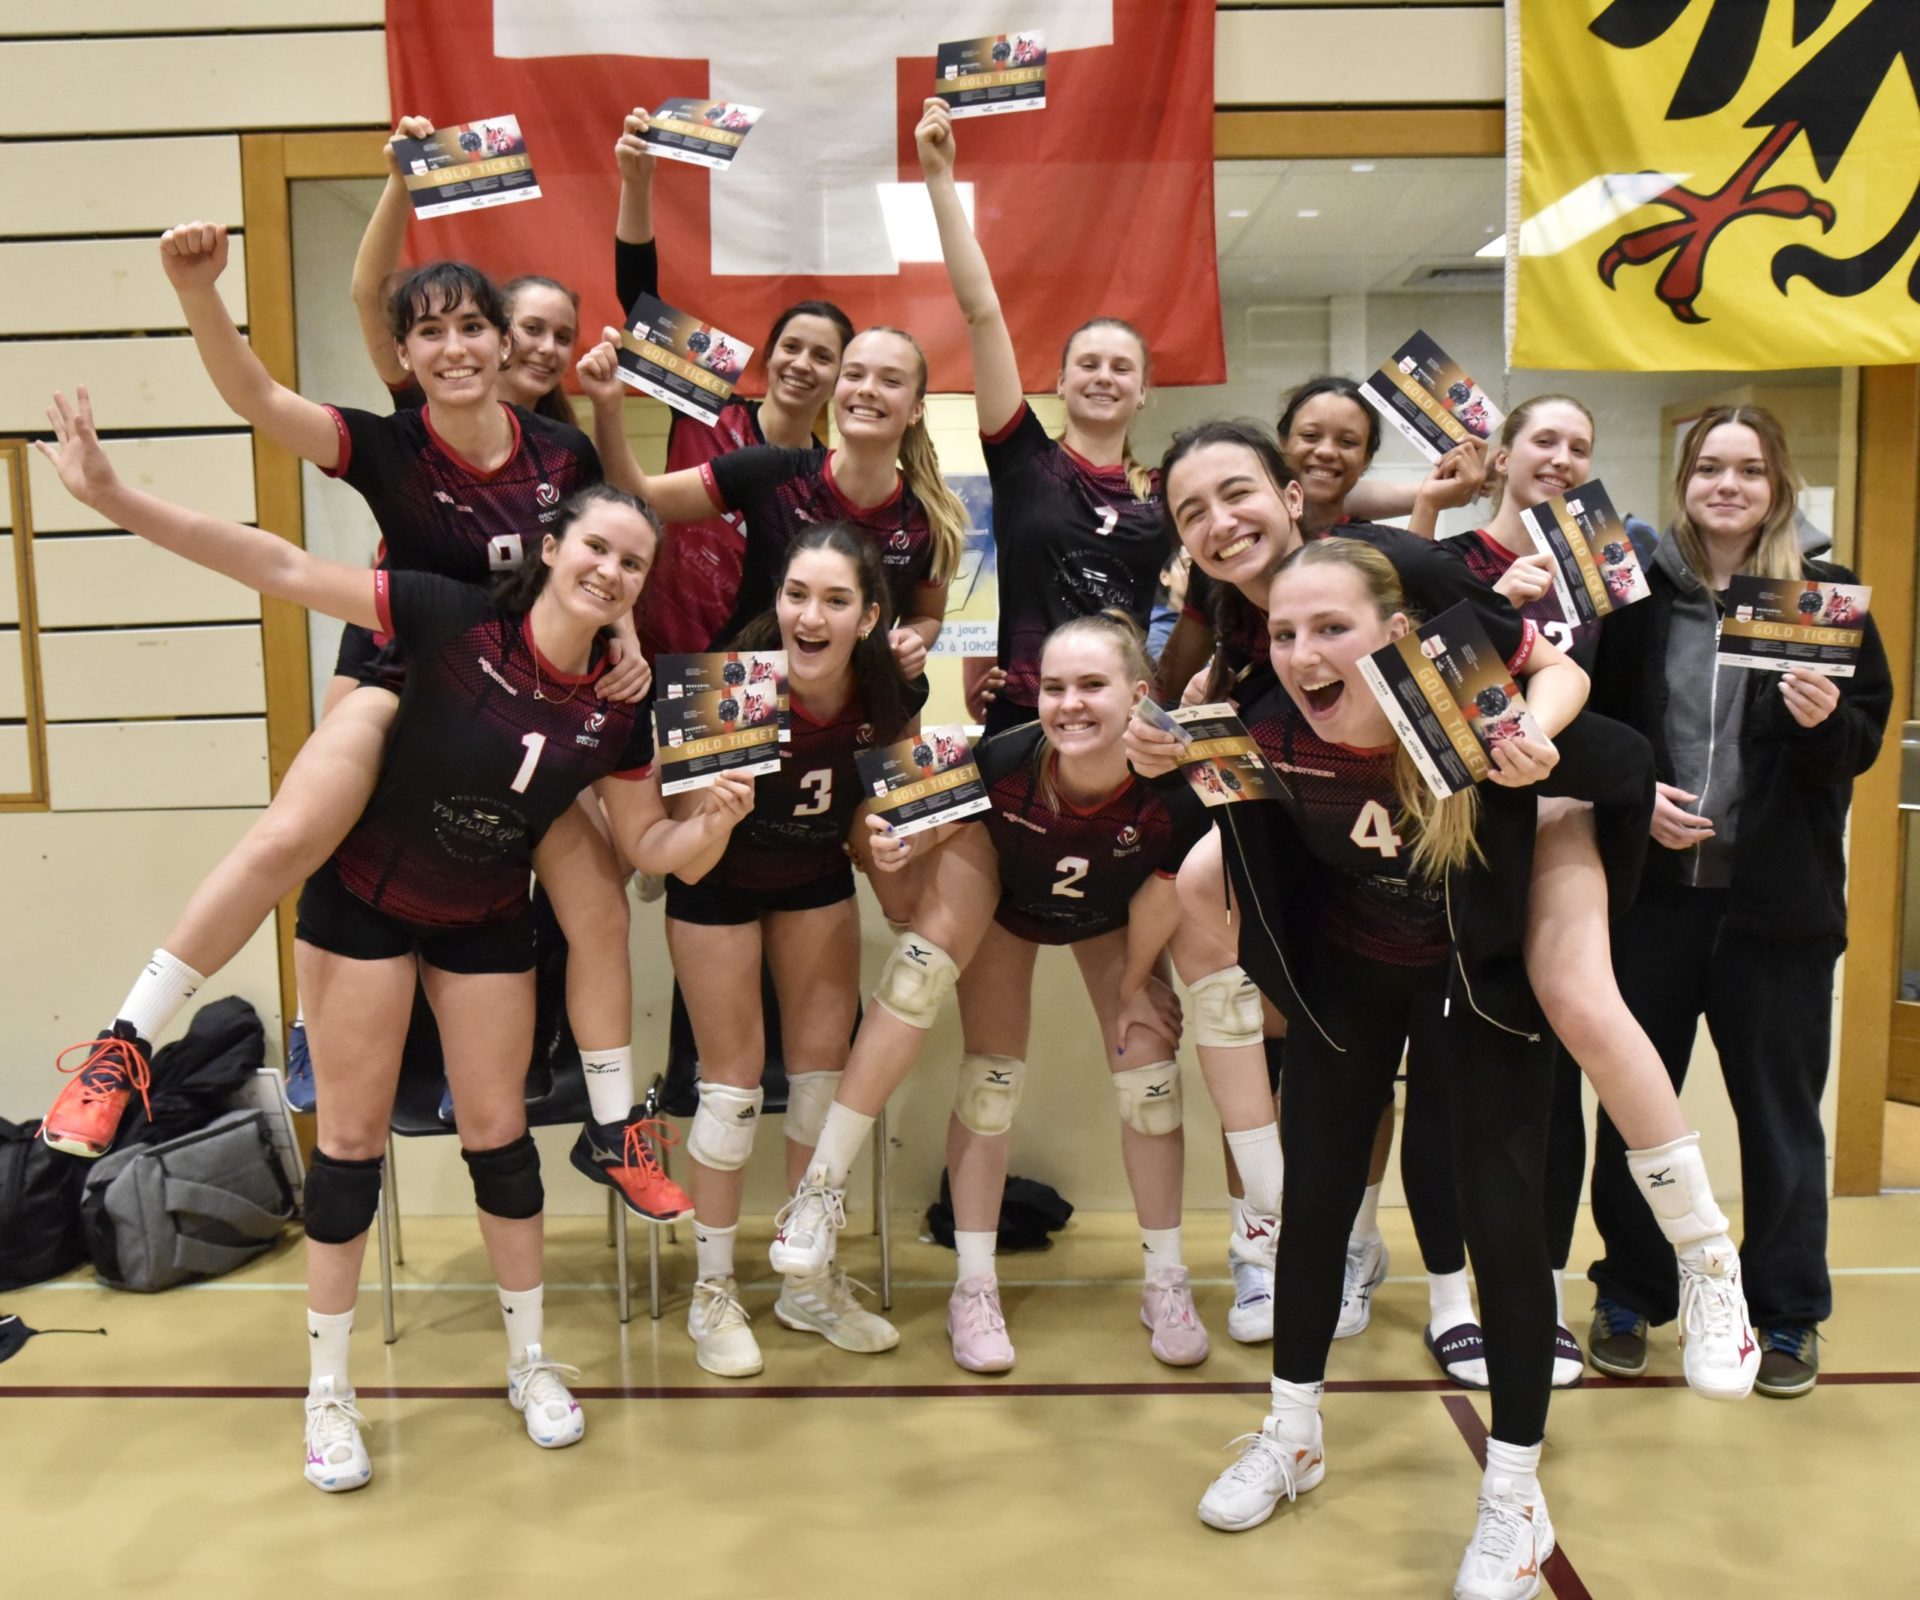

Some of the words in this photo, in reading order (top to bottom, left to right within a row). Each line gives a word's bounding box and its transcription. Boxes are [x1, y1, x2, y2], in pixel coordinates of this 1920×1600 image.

[1435, 409, 1463, 440] TICK
[957, 624, 987, 637] jours
[1752, 624, 1794, 638] GOLD
[1802, 629, 1858, 644] TICKET
[1418, 666, 1451, 713] GOLD
[1447, 716, 1489, 775] TICKET
[686, 739, 722, 755] GOLD
[728, 728, 775, 747] TICKET
[510, 732, 546, 794] 1
[793, 768, 833, 816] 3
[892, 783, 925, 803] GOLD
[931, 767, 975, 789] TICKET
[1350, 800, 1402, 858] 4
[1052, 856, 1089, 898] 2
[1442, 1336, 1483, 1353] NAUTI
[1555, 1337, 1580, 1351] TICA
